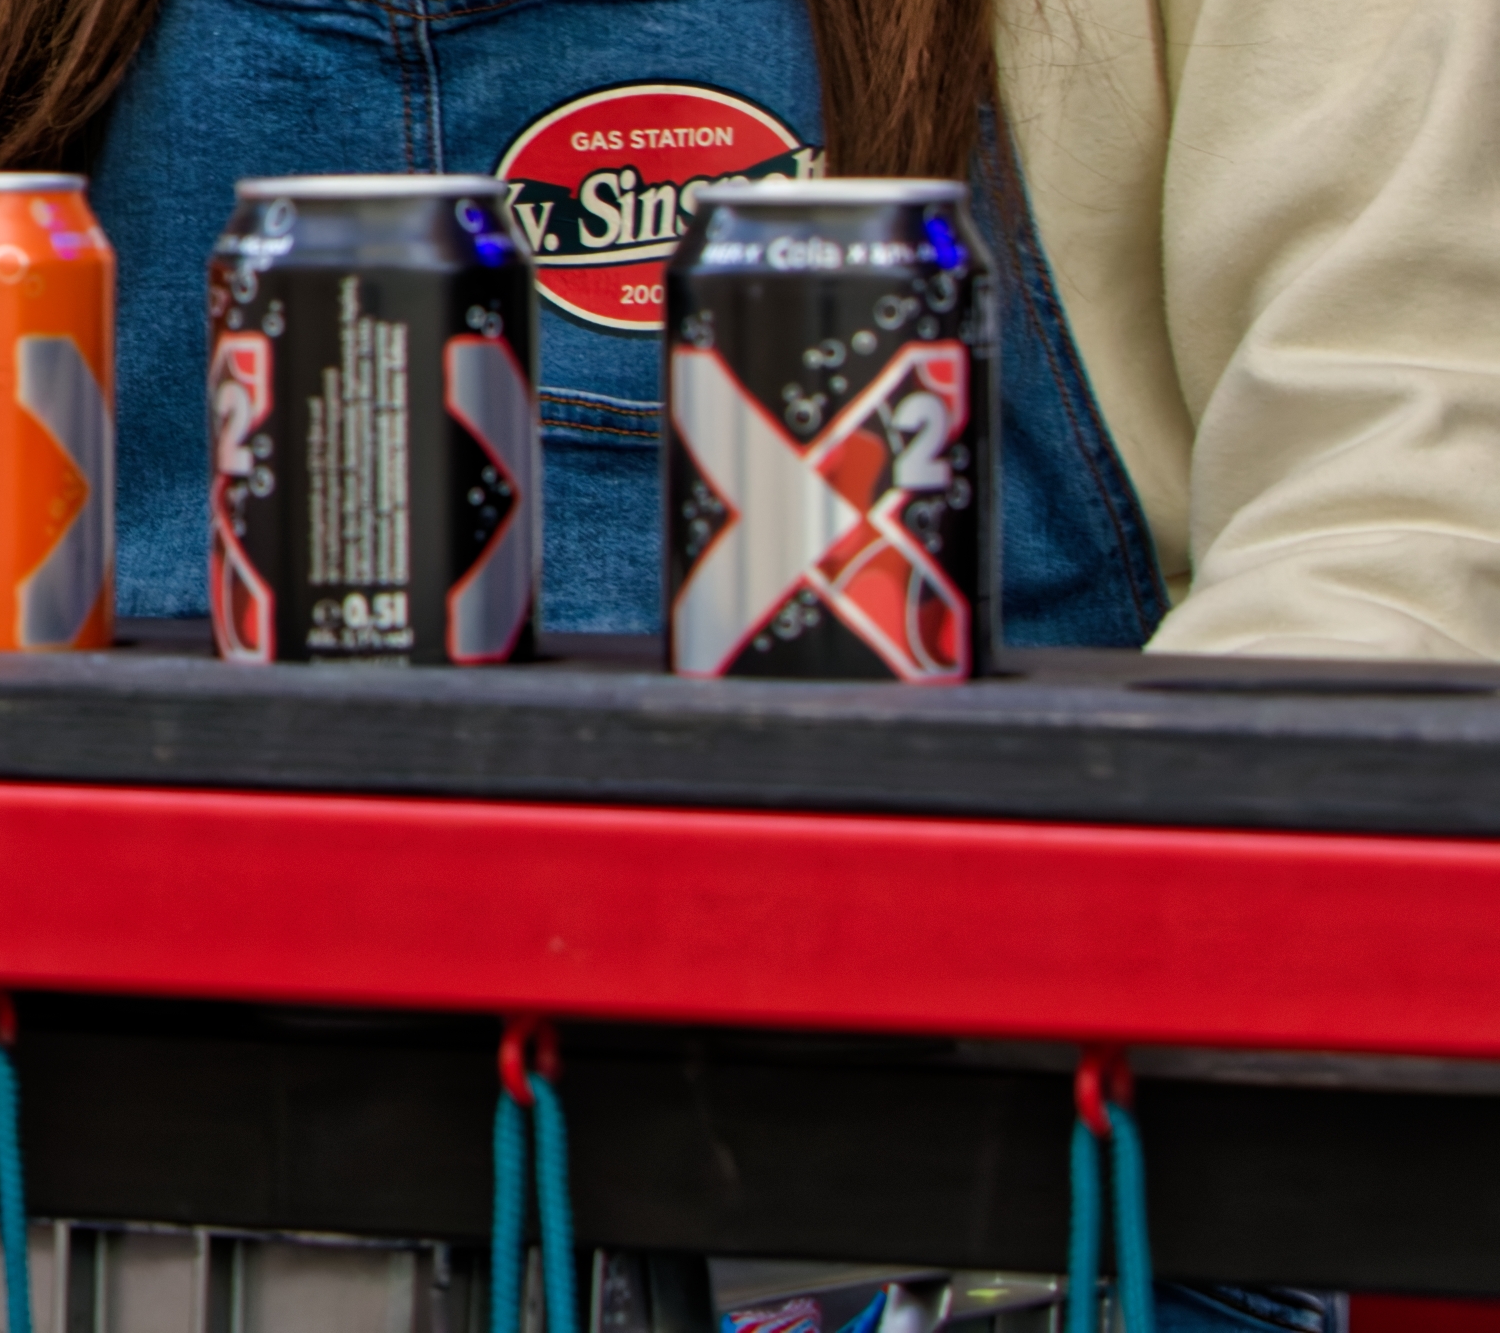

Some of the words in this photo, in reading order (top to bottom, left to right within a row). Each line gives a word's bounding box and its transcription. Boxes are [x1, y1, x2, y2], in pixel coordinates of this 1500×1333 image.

[570, 129, 624, 152] GAS
[630, 126, 734, 150] STATION
[619, 283, 665, 306] 200
